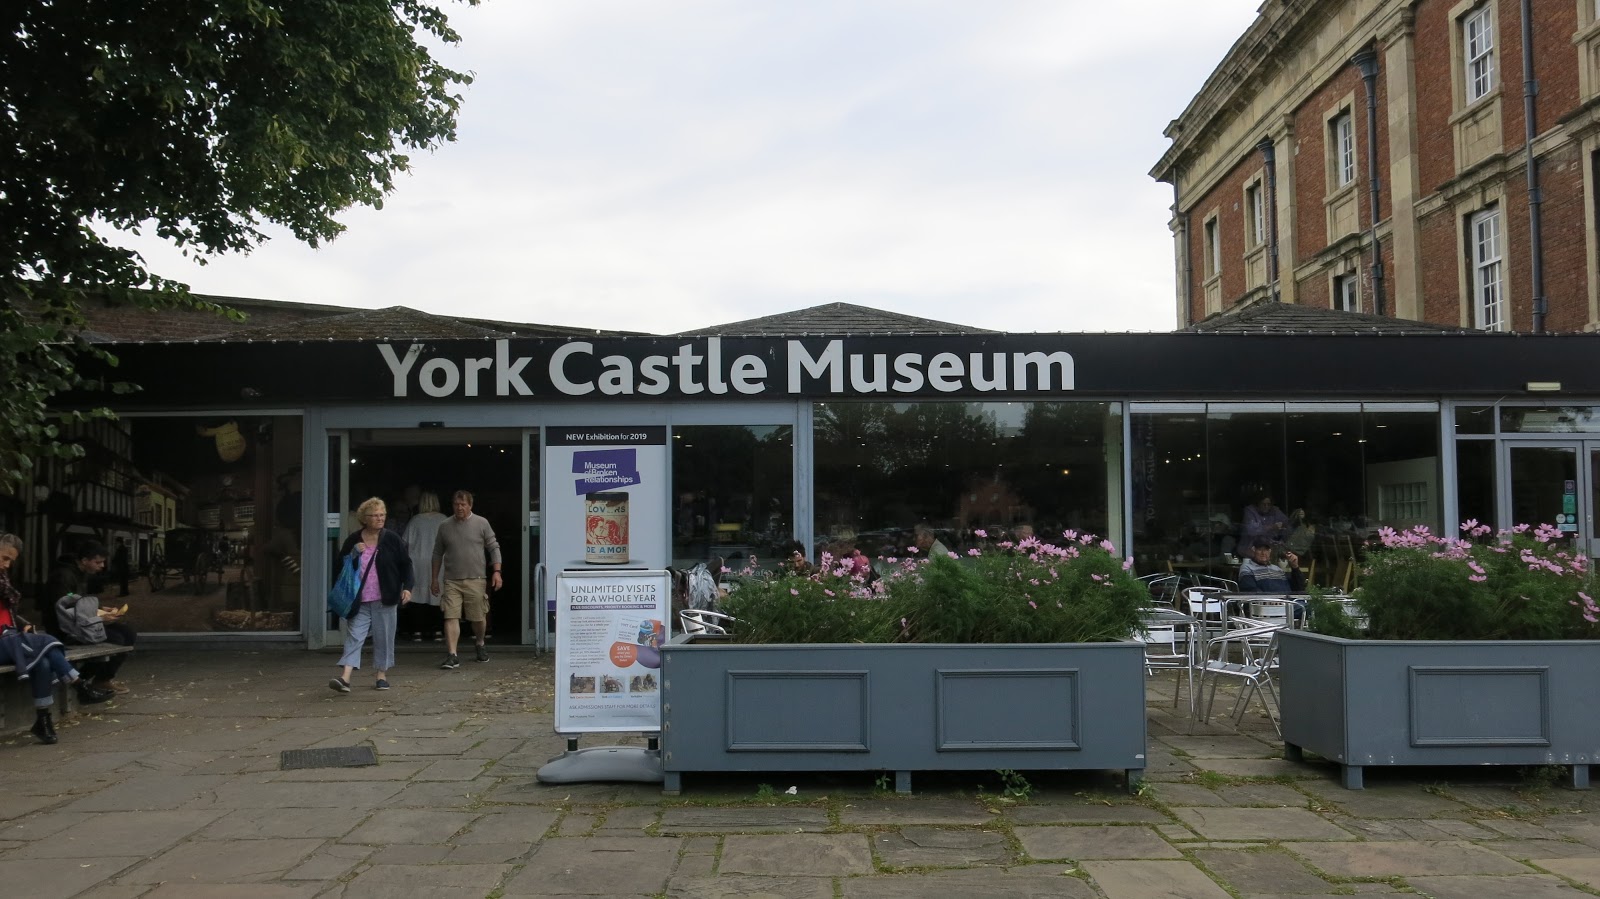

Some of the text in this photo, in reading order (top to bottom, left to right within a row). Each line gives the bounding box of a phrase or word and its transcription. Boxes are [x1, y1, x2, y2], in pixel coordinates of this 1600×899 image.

[377, 337, 1075, 398] York Castle Museum
[584, 475, 633, 484] Relationships
[571, 584, 656, 594] UNLIMITED VISITS
[570, 594, 656, 603] FOR A WHOLE YEAR
